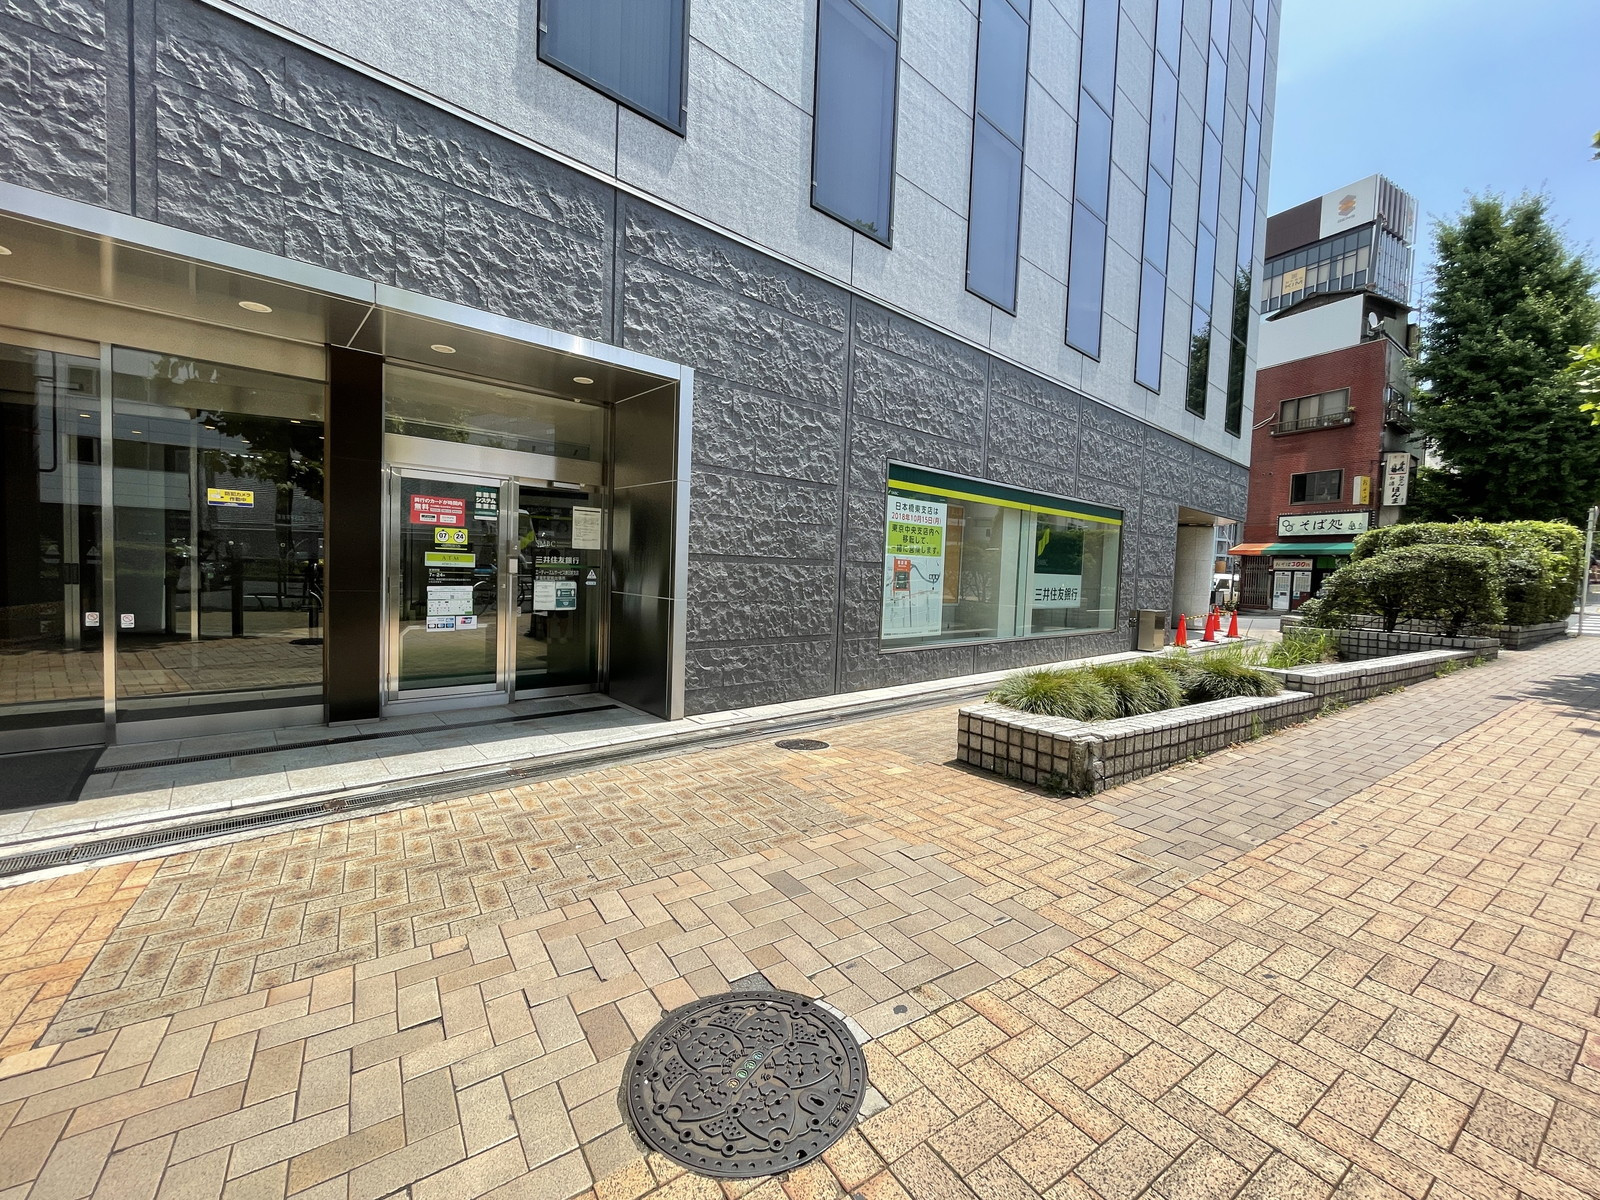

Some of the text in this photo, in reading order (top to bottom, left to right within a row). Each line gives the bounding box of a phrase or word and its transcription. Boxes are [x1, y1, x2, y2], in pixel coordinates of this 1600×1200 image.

[895, 501, 939, 515] 日本橋東支店は
[891, 523, 940, 536] 東京中央支店内へ
[1299, 518, 1343, 531] そば処
[535, 555, 580, 565] 三井住友銀行
[1034, 587, 1078, 601] 三井住友銀行
